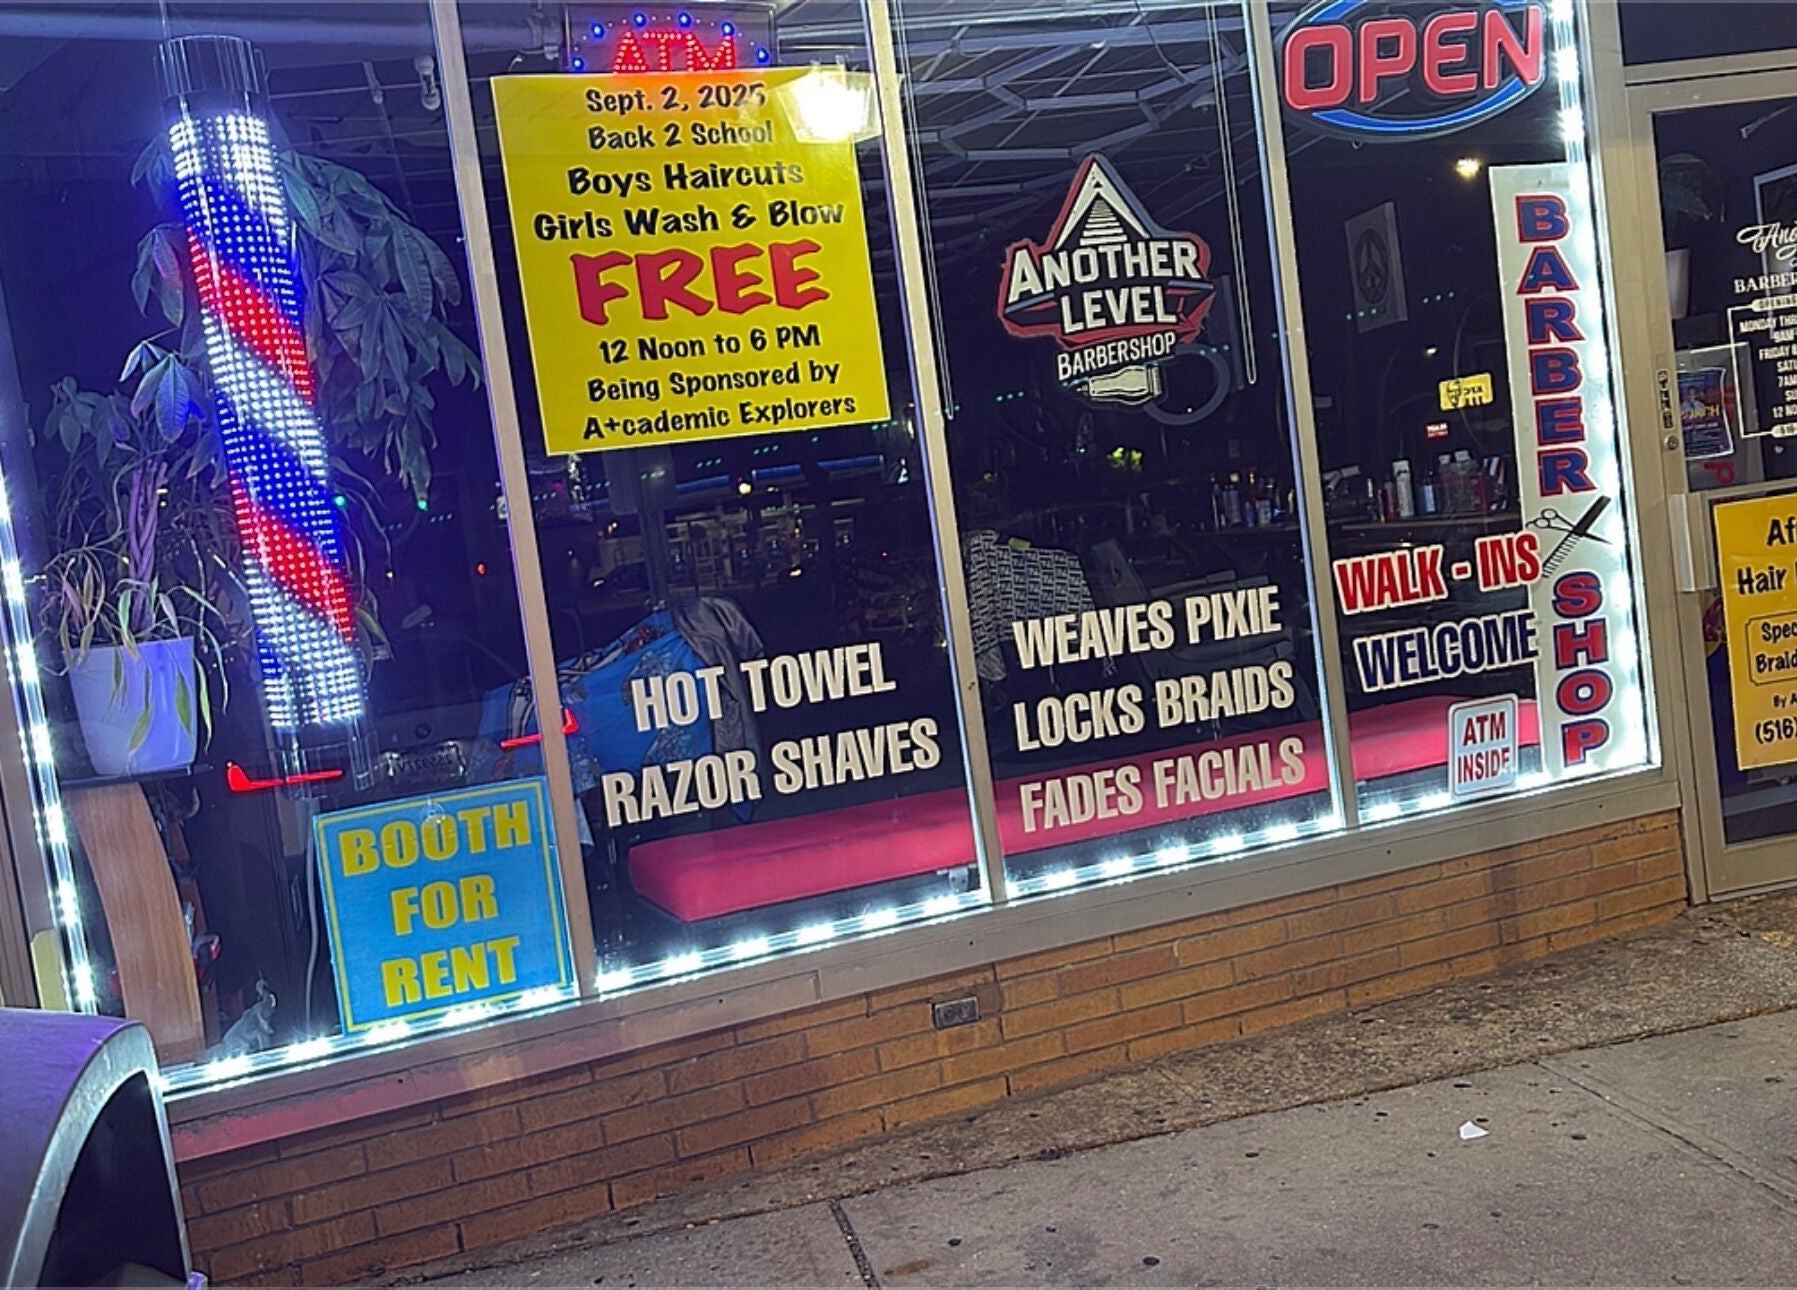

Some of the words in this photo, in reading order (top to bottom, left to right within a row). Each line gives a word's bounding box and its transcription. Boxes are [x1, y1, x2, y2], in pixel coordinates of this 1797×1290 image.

[612, 31, 736, 73] ATM
[1285, 5, 1545, 109] OPEN
[585, 87, 652, 114] Sept.
[662, 86, 690, 112] 2,
[699, 83, 766, 109] 2025
[588, 124, 655, 149] Back
[665, 122, 682, 146] 2
[692, 120, 773, 145] School
[568, 166, 652, 198] Boys
[664, 161, 804, 191] Haircuts
[534, 210, 613, 241] Girls
[624, 205, 719, 236] Wash
[732, 203, 757, 229] &
[769, 200, 844, 227] Blow
[570, 239, 830, 326] FREE
[1008, 240, 1201, 304] ANOTHER
[1060, 286, 1177, 334] LEVEL
[600, 340, 629, 365] 12
[638, 335, 704, 361] Noon
[715, 333, 739, 354] to
[750, 328, 767, 351] 6
[776, 324, 821, 349] PM
[1057, 332, 1176, 380] BARBERSHOP
[1515, 194, 1597, 497] BARBER
[588, 378, 660, 404] Being
[670, 363, 800, 397] Sponsored
[809, 360, 840, 385] by
[583, 407, 731, 440] A+cademic
[739, 396, 857, 426] Explorers
[1335, 546, 1447, 613] WALK
[1476, 533, 1541, 591] INS
[1737, 565, 1787, 595] Hair
[1012, 600, 1174, 669] WEAVES
[1185, 585, 1282, 645] PIXIE
[1355, 611, 1540, 692] WELCOME
[631, 666, 724, 732] HOT
[740, 642, 896, 713] TOWEL
[1552, 571, 1613, 767] SHOP
[1014, 684, 1145, 752] LOCKS
[1155, 661, 1295, 728] BRAIDS
[1463, 711, 1506, 746] ATM
[602, 749, 761, 826] RAZOR
[772, 717, 941, 794] SHAVES
[1019, 766, 1143, 833] FADES
[1153, 737, 1305, 809] FACIALS
[1457, 747, 1511, 784] INSIDE
[338, 801, 532, 877] BOOTH
[390, 875, 498, 936] FOR
[381, 937, 520, 1008] RENT
